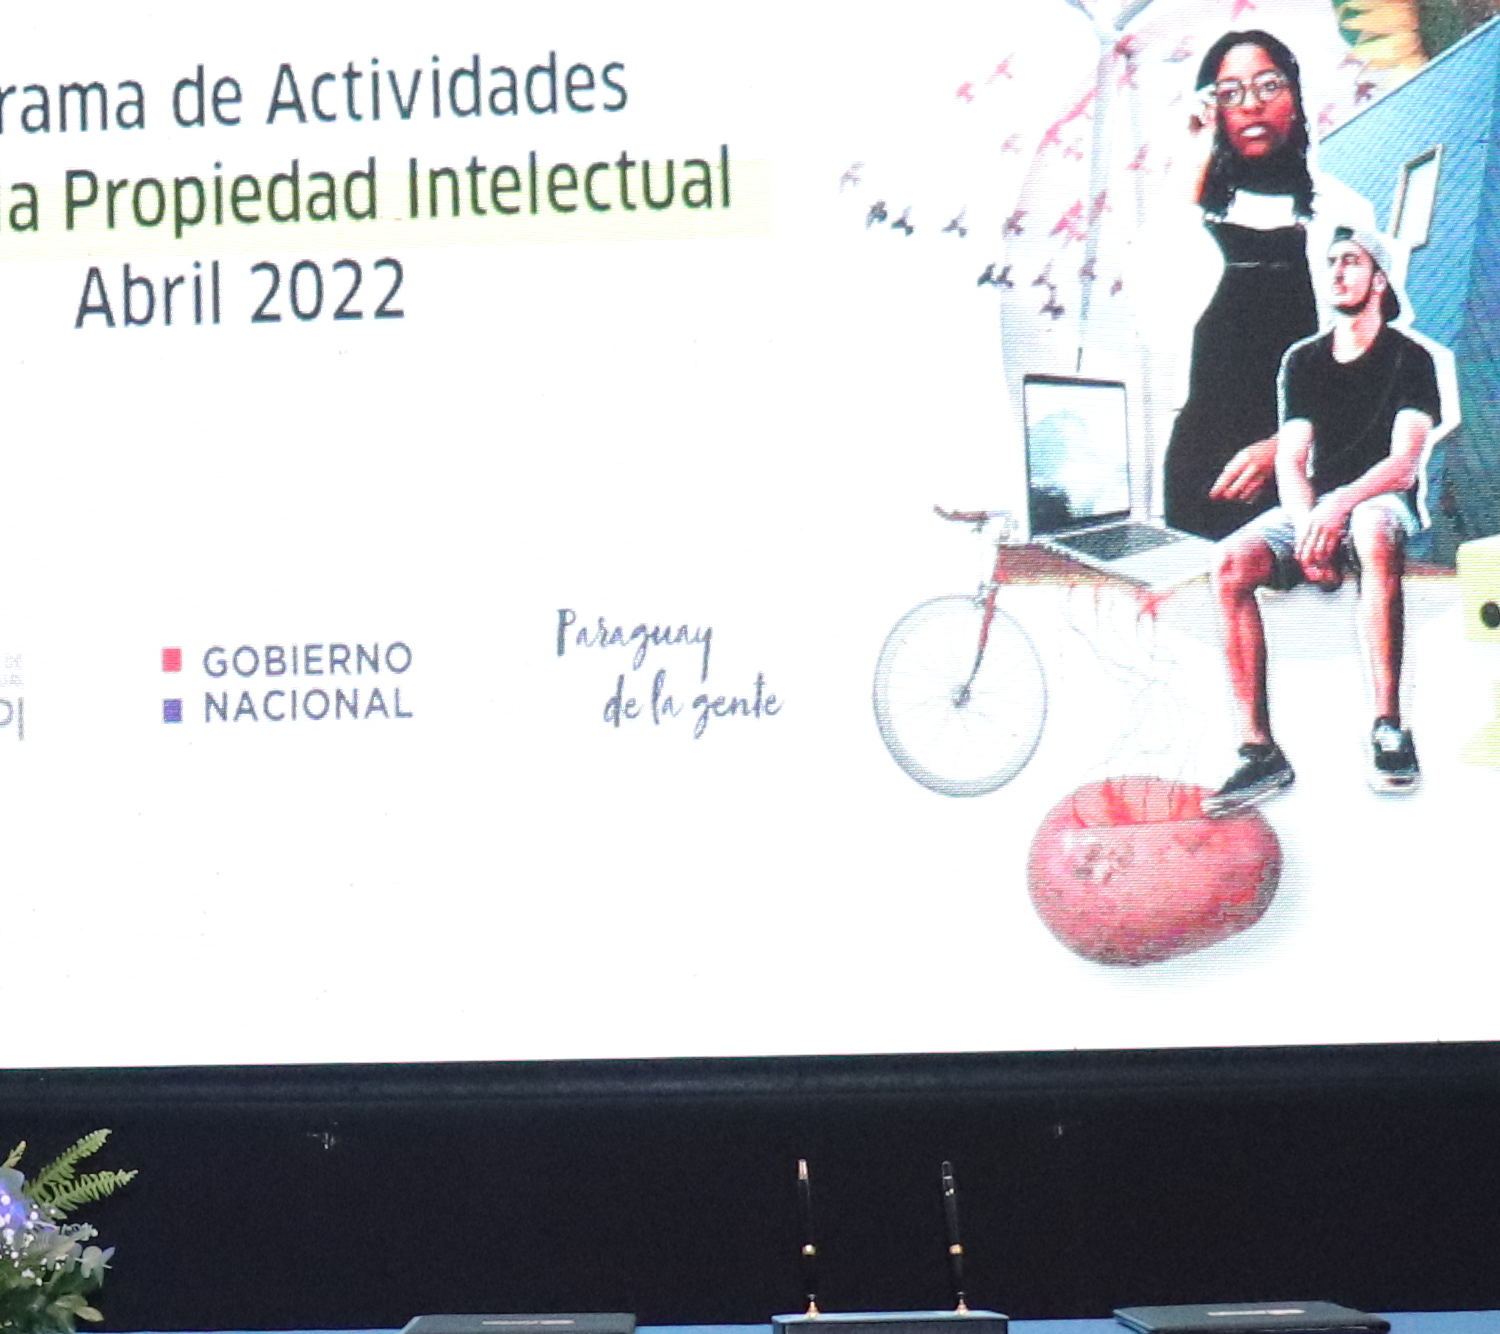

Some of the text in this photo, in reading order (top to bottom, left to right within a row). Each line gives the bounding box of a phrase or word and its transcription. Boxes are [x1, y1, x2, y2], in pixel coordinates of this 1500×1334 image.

[172, 64, 243, 129] de
[265, 49, 629, 125] Actividades
[65, 155, 378, 240] Propiedad
[408, 143, 731, 219] Intelectual
[74, 256, 406, 330] Abril 2022
[203, 641, 413, 679] GOBIERNO
[557, 608, 713, 684] Paraguay
[204, 687, 414, 723] NACIONAL
[602, 668, 786, 740] de la gente
